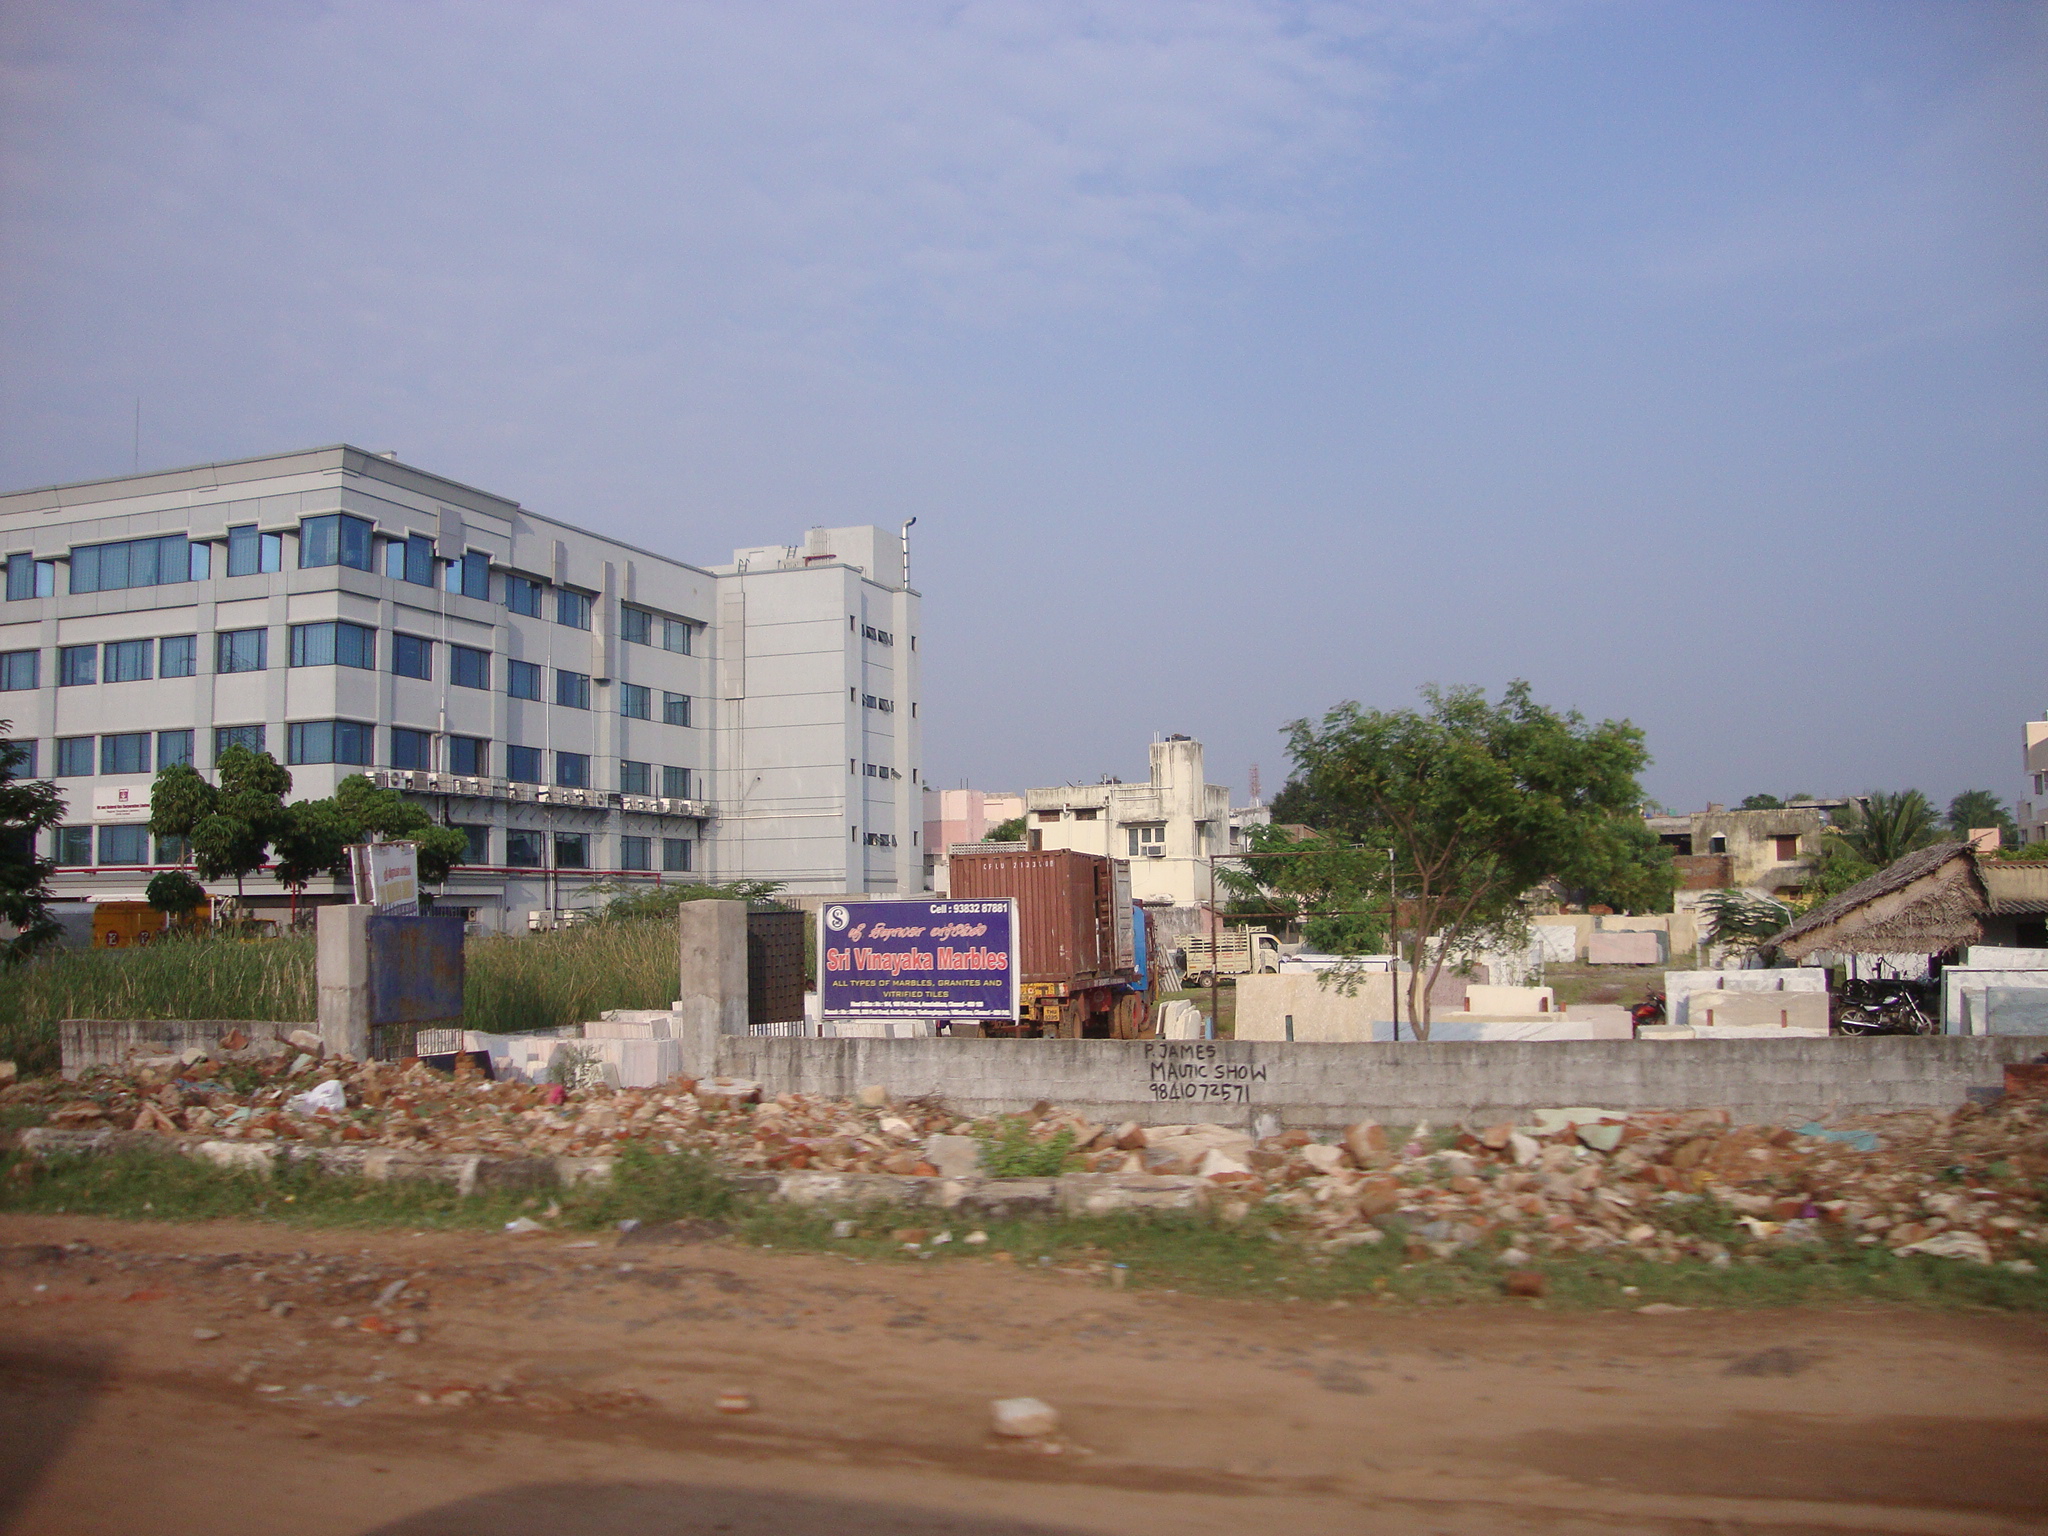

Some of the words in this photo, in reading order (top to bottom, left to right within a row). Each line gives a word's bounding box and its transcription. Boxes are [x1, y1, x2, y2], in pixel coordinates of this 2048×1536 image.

[930, 904, 947, 914] Cell
[953, 903, 980, 913] 93832
[981, 903, 1008, 913] 87881
[826, 947, 851, 971] Sri
[853, 947, 934, 976] Vinayaka
[936, 946, 1008, 971] Marbles
[983, 979, 1003, 987] AND
[1214, 1064, 1267, 1081] SHOW
